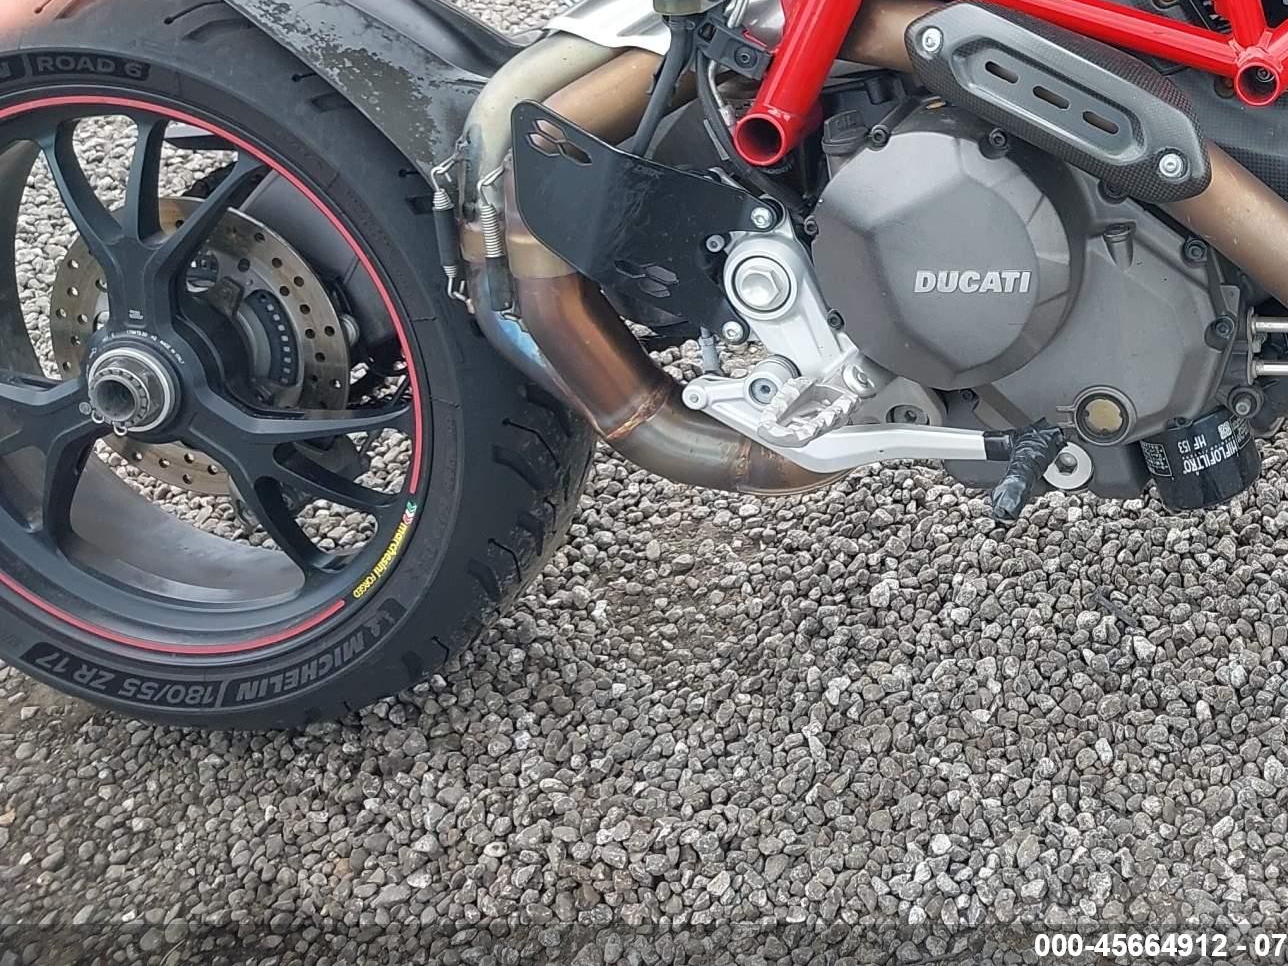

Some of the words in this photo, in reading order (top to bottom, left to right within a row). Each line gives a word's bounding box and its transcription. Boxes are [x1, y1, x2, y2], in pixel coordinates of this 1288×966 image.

[36, 56, 116, 73] ROAD
[124, 61, 143, 78] 6
[914, 270, 1032, 293] DUCATI
[1193, 434, 1207, 450] HF
[373, 521, 408, 578] marchesini
[352, 572, 377, 599] FORGED
[35, 651, 70, 673] 17
[235, 631, 365, 702] MICHELIN
[72, 664, 116, 690] ZR
[117, 677, 215, 705] 180/55
